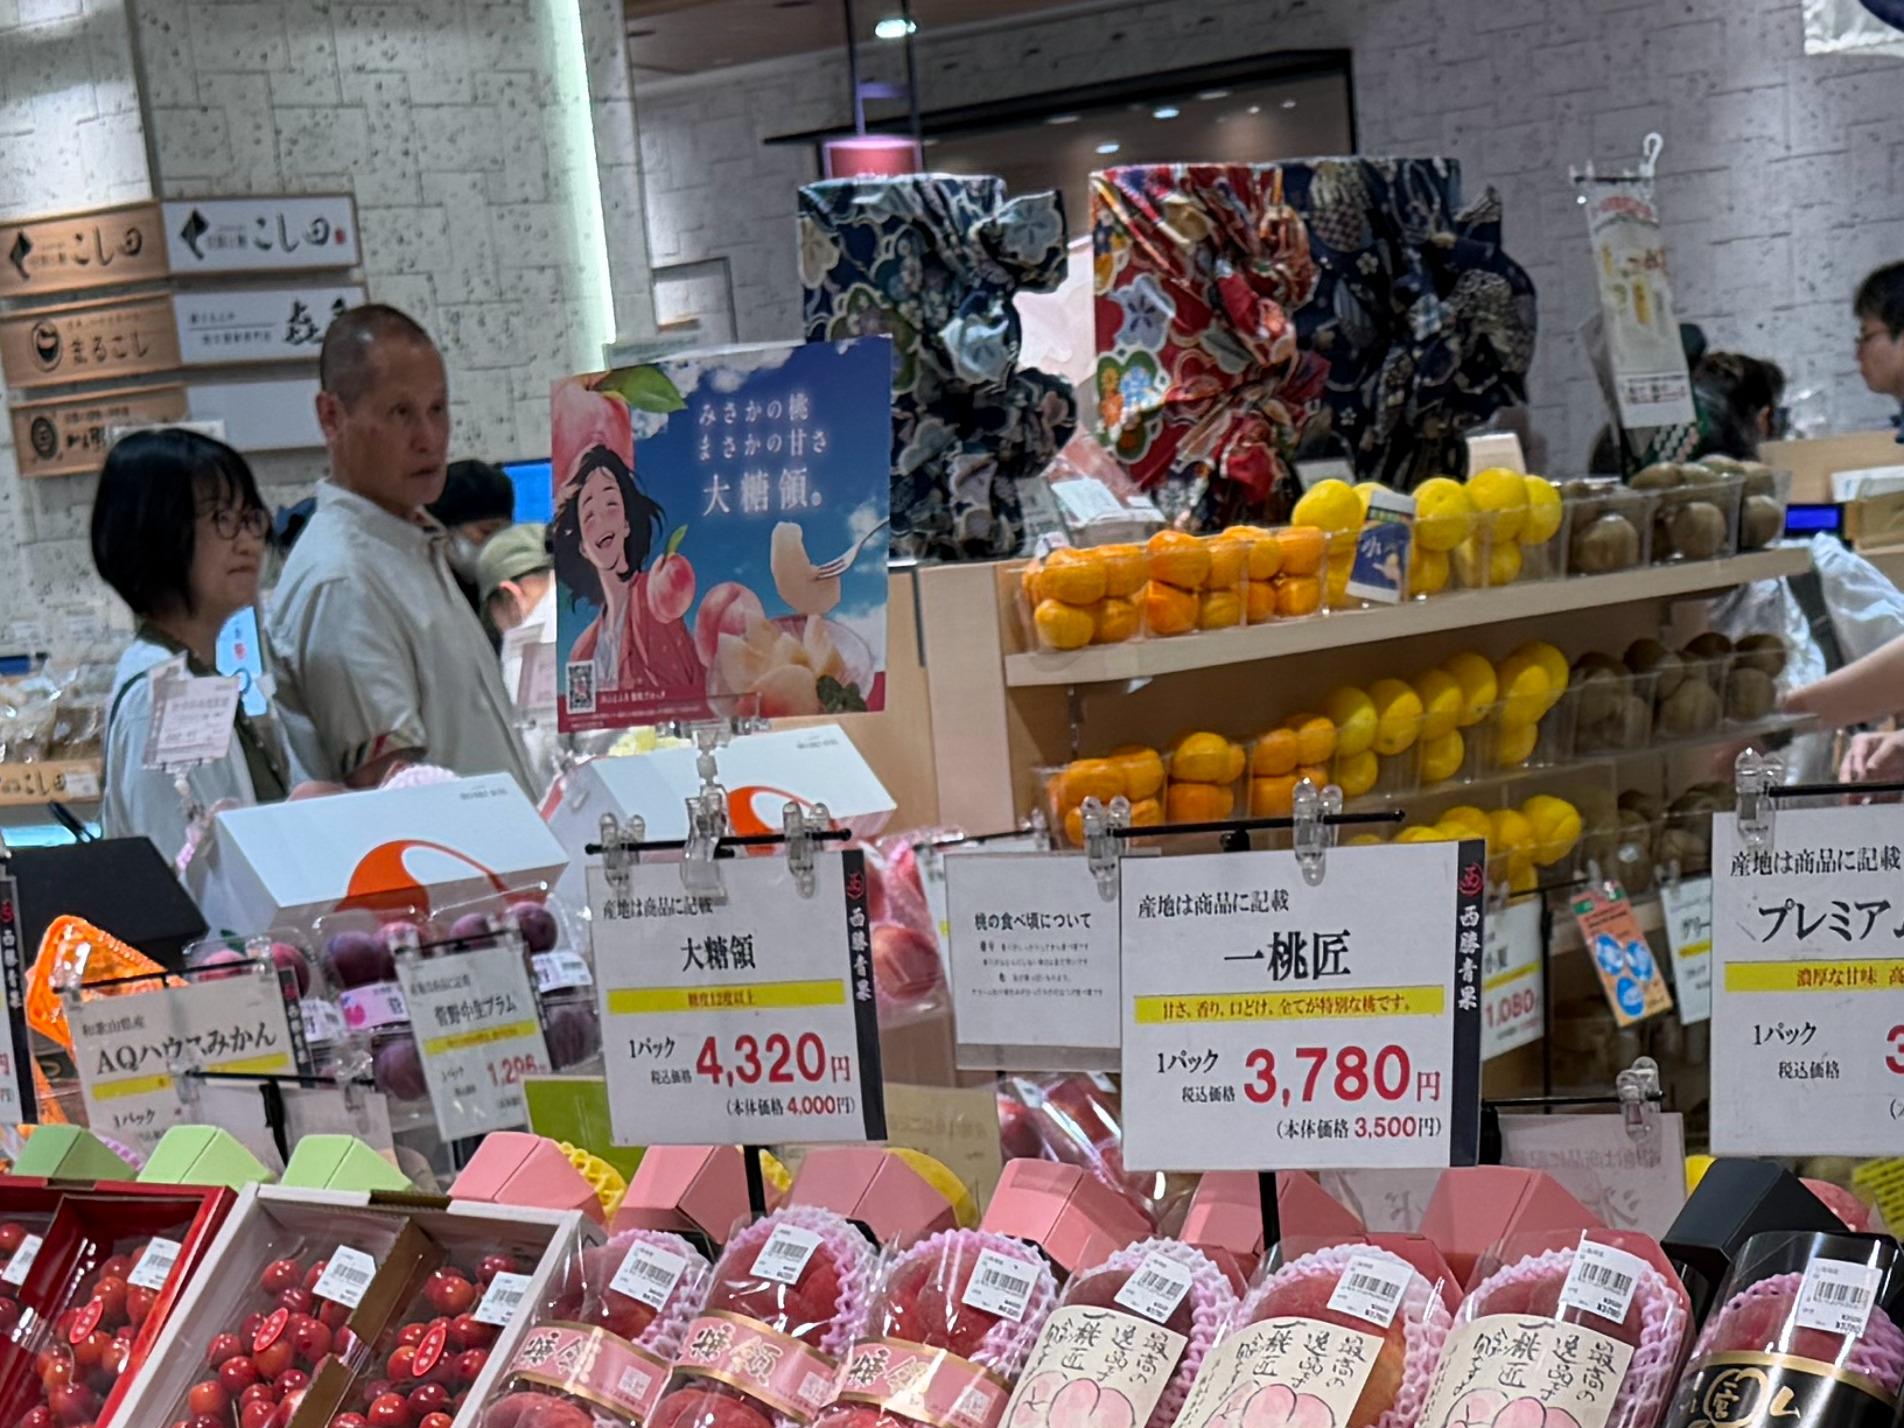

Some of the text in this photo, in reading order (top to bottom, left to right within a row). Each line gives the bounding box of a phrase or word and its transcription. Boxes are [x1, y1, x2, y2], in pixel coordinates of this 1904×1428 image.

[698, 393, 810, 428] みさかの桃
[698, 430, 830, 462] まさかの甘さ
[701, 467, 826, 516] 大糖領。
[1730, 844, 1901, 878] 産地は商品に記載
[602, 891, 713, 920] 産地は商品に記載
[1137, 890, 1291, 919] 産地は商品に記載
[973, 910, 1092, 930] 桃の食べ頃について
[680, 931, 756, 972] 大糖領
[1223, 930, 1351, 980] 一桃匠
[1458, 905, 1480, 1012] 西勝青果
[1795, 965, 1879, 989] 濃厚な甘味
[628, 1036, 676, 1060] 1パック
[1753, 1021, 1817, 1048] 1パック
[650, 1030, 851, 1087] 税込価格 4,320円
[1155, 1048, 1219, 1075] 1パック
[1778, 1059, 1841, 1080] 税込価格
[1180, 1042, 1441, 1105] 税込価格 3,780円
[725, 1093, 856, 1117] (本体価格 4,000円)
[1276, 1116, 1442, 1140] (本体価格 3,500円)
